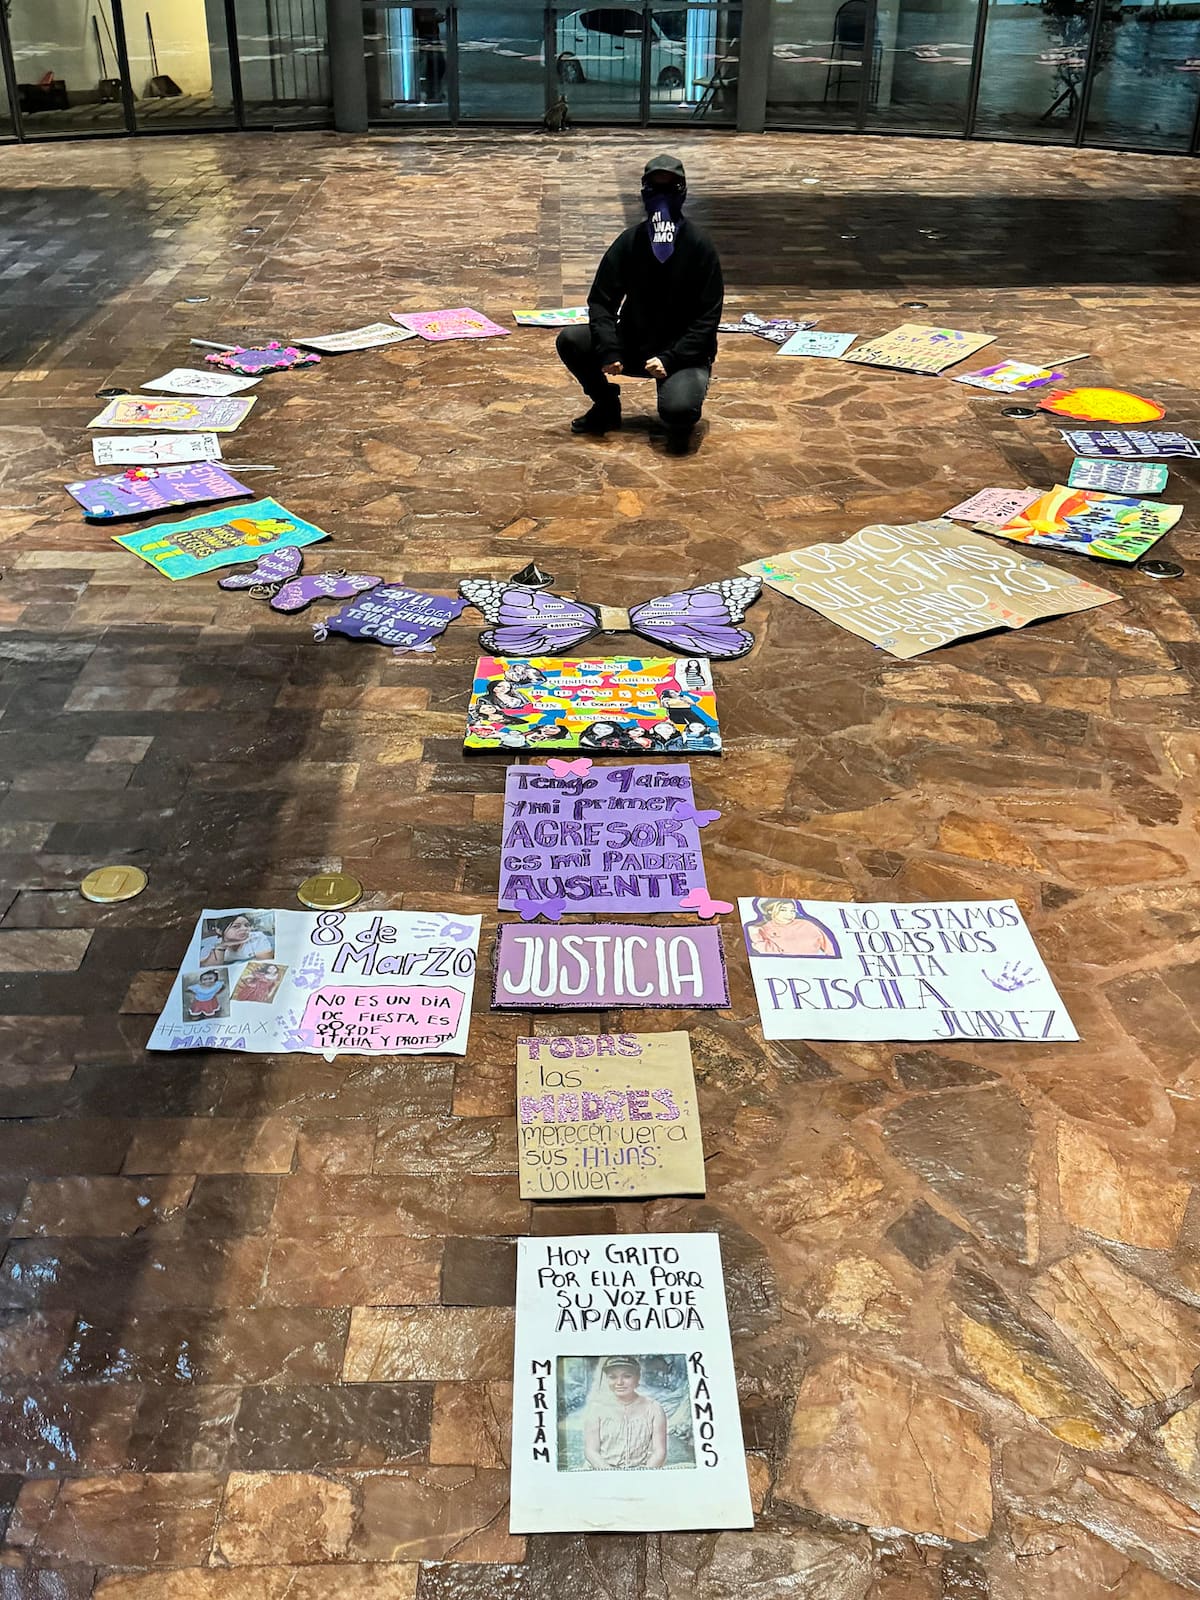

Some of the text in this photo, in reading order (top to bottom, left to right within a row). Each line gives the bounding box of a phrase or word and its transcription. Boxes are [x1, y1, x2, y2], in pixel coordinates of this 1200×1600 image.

[375, 589, 434, 607] SOY LA
[791, 574, 877, 613] QUE
[359, 602, 451, 628] QUE SIEMPRE
[838, 583, 991, 638] LUCHANDO
[359, 624, 419, 646] CREER
[508, 772, 598, 796] Tengo
[636, 771, 692, 790] años
[573, 796, 687, 821] primer
[503, 819, 690, 850] AGRESOR
[504, 849, 698, 873] es mi PADRE
[502, 873, 691, 901] AUSENTE
[310, 911, 398, 946] 8 de
[838, 905, 1020, 930] NO ESTAMOS
[846, 930, 998, 954] TODAS NOS
[502, 935, 704, 998] JUSTICIA
[857, 953, 949, 977] FALTA
[315, 993, 347, 1007] NO
[354, 995, 379, 1007] ES
[386, 995, 411, 1006] UN
[764, 977, 955, 1010] PRISCILA
[357, 1024, 384, 1036] DE
[427, 1014, 451, 1026] ES
[932, 1009, 1066, 1039] JUAREZ
[380, 1035, 391, 1047] Y
[395, 1032, 455, 1047] PROTESTA
[517, 1032, 644, 1061] TODAS
[540, 1065, 583, 1089] las
[519, 1087, 681, 1125] MADRES
[521, 1123, 613, 1147] merecen
[526, 1148, 569, 1166] sus
[546, 1243, 680, 1267] HOY GRITO
[537, 1266, 706, 1289] POR ELLA PORQ
[556, 1289, 698, 1309] SU VOZ FUE
[554, 1307, 706, 1333] APAGADA
[531, 1359, 552, 1463] MIRIAM
[688, 1350, 720, 1468] RAMOS
